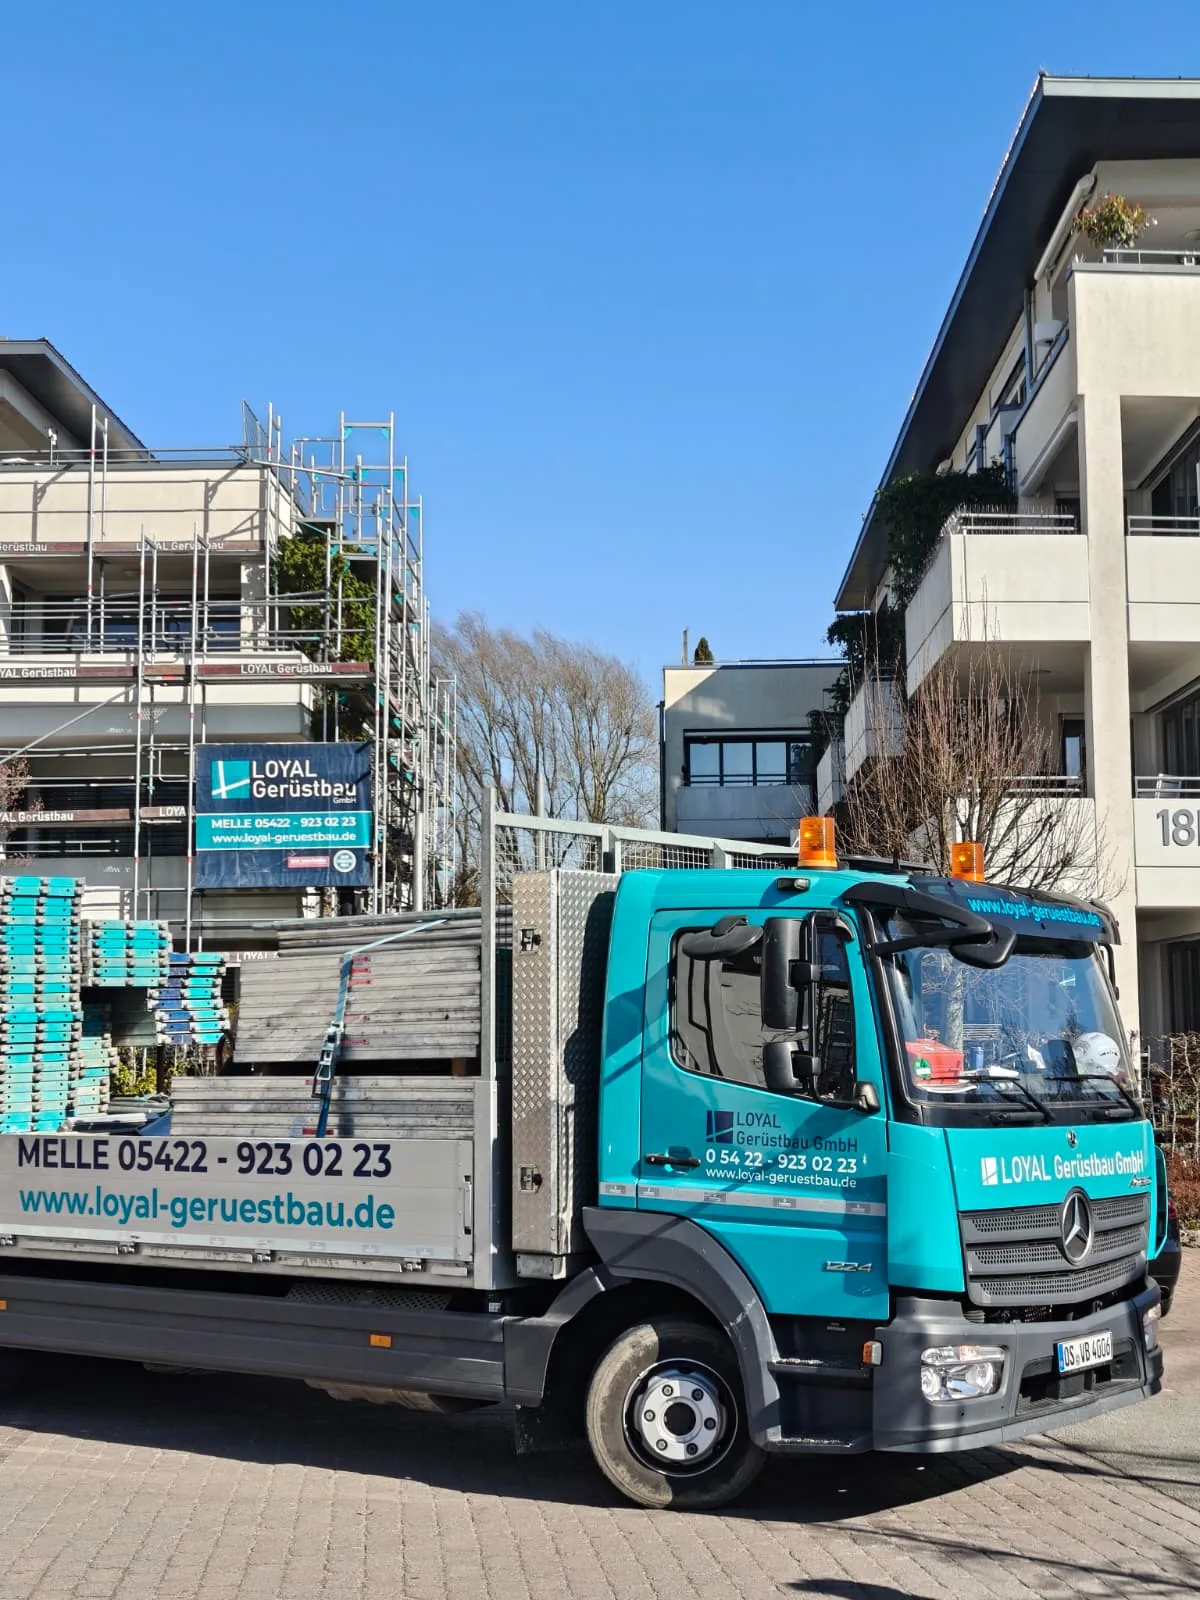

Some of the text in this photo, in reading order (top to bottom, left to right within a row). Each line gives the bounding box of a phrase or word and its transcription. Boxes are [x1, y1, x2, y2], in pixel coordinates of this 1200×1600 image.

[0, 541, 47, 552] erüstbau
[21, 667, 77, 678] Gerüstbau
[240, 663, 333, 674] LOYAL Gerüstbau
[252, 760, 317, 778] LOYAL
[252, 780, 356, 798] Gerüstbau
[18, 811, 74, 822] Gerüstbau
[211, 818, 252, 829] MELLE
[255, 818, 290, 828] 05422
[301, 817, 322, 828] 923
[324, 817, 339, 827] 02
[341, 816, 356, 826] 23
[1156, 808, 1200, 847] 18
[212, 831, 356, 844] www.loyal-geruestbau.de
[967, 898, 1100, 927] www.loyal-geruestbau.de
[736, 1111, 781, 1128] LOYAL
[736, 1131, 858, 1152] Gerüstbau GmbH
[18, 1137, 110, 1170] MELLE
[118, 1140, 208, 1173] 05422
[236, 1141, 292, 1175] 923
[303, 1142, 343, 1177] 02
[352, 1143, 392, 1178] 23
[705, 1149, 716, 1163] 0
[720, 1150, 741, 1164] 54
[744, 1151, 763, 1167] 22
[778, 1154, 807, 1169] 923
[812, 1156, 833, 1171] 02
[837, 1158, 857, 1173] 23
[1001, 1150, 1144, 1184] LOYAL Gerüstbau GmbH
[705, 1168, 857, 1188] www.loyal-geruestbau.de
[19, 1185, 395, 1230] www.loyal-geruestbau.de
[1064, 1337, 1110, 1367] OS VB 4006
